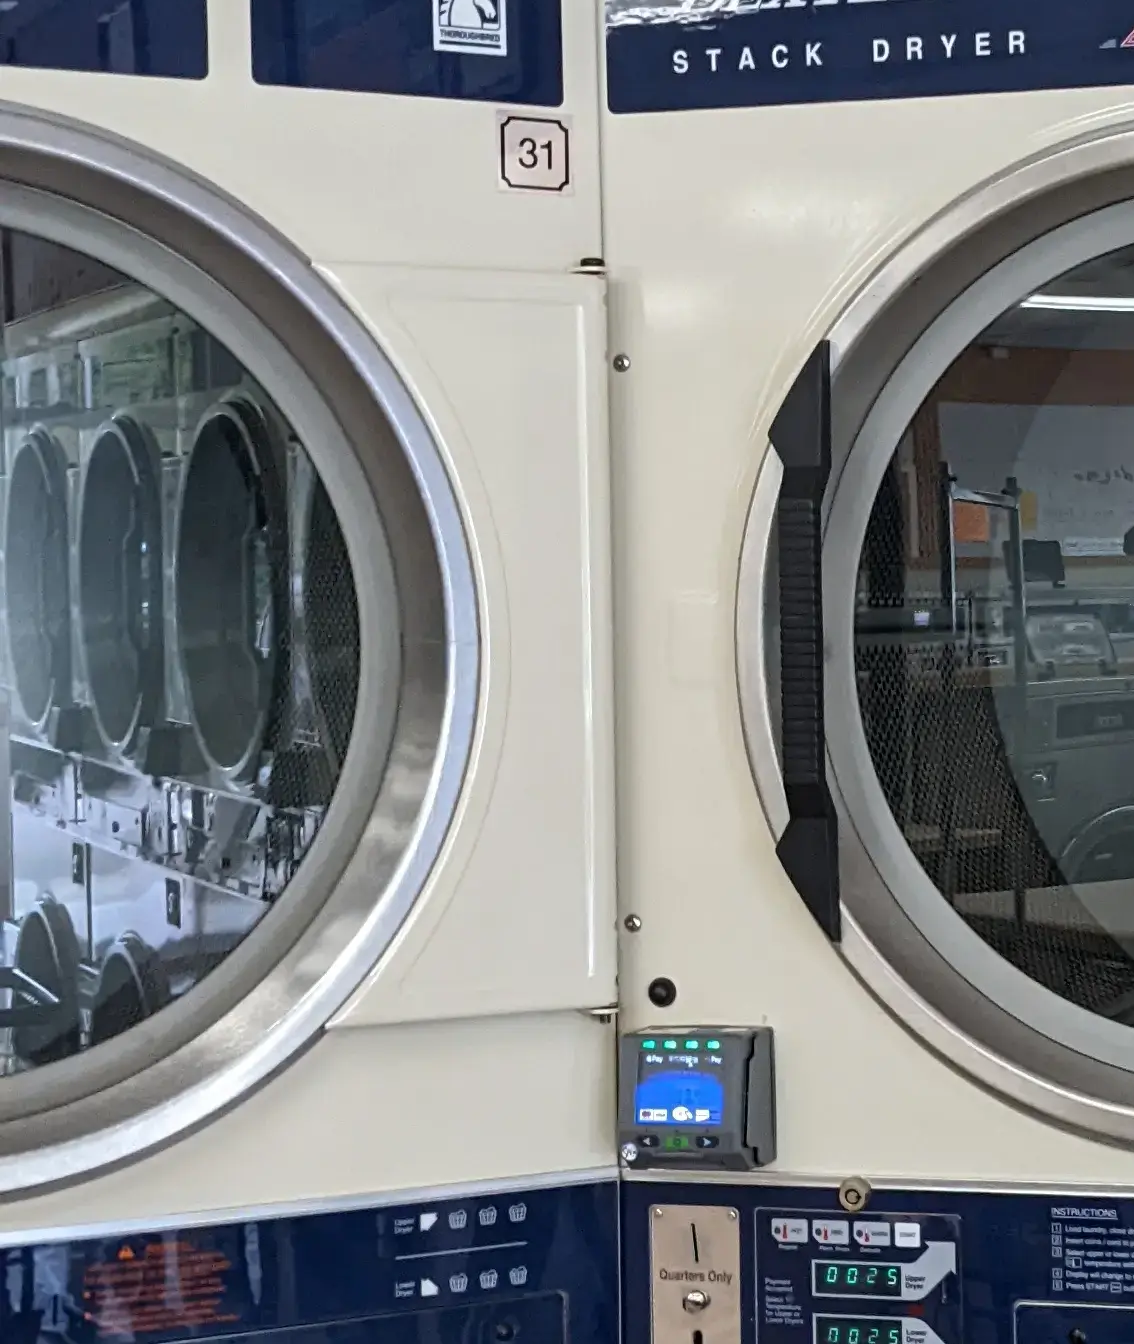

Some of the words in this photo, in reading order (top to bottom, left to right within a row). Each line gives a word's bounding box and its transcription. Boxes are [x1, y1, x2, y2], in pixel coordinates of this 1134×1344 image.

[673, 42, 824, 74] STACK
[872, 30, 1027, 62] DRYER
[517, 137, 553, 170] 31
[1051, 1207, 1117, 1218] INSTRUCTIONS
[659, 1268, 706, 1283] Quarters
[707, 1269, 733, 1286] Only
[826, 1266, 898, 1286] 0025
